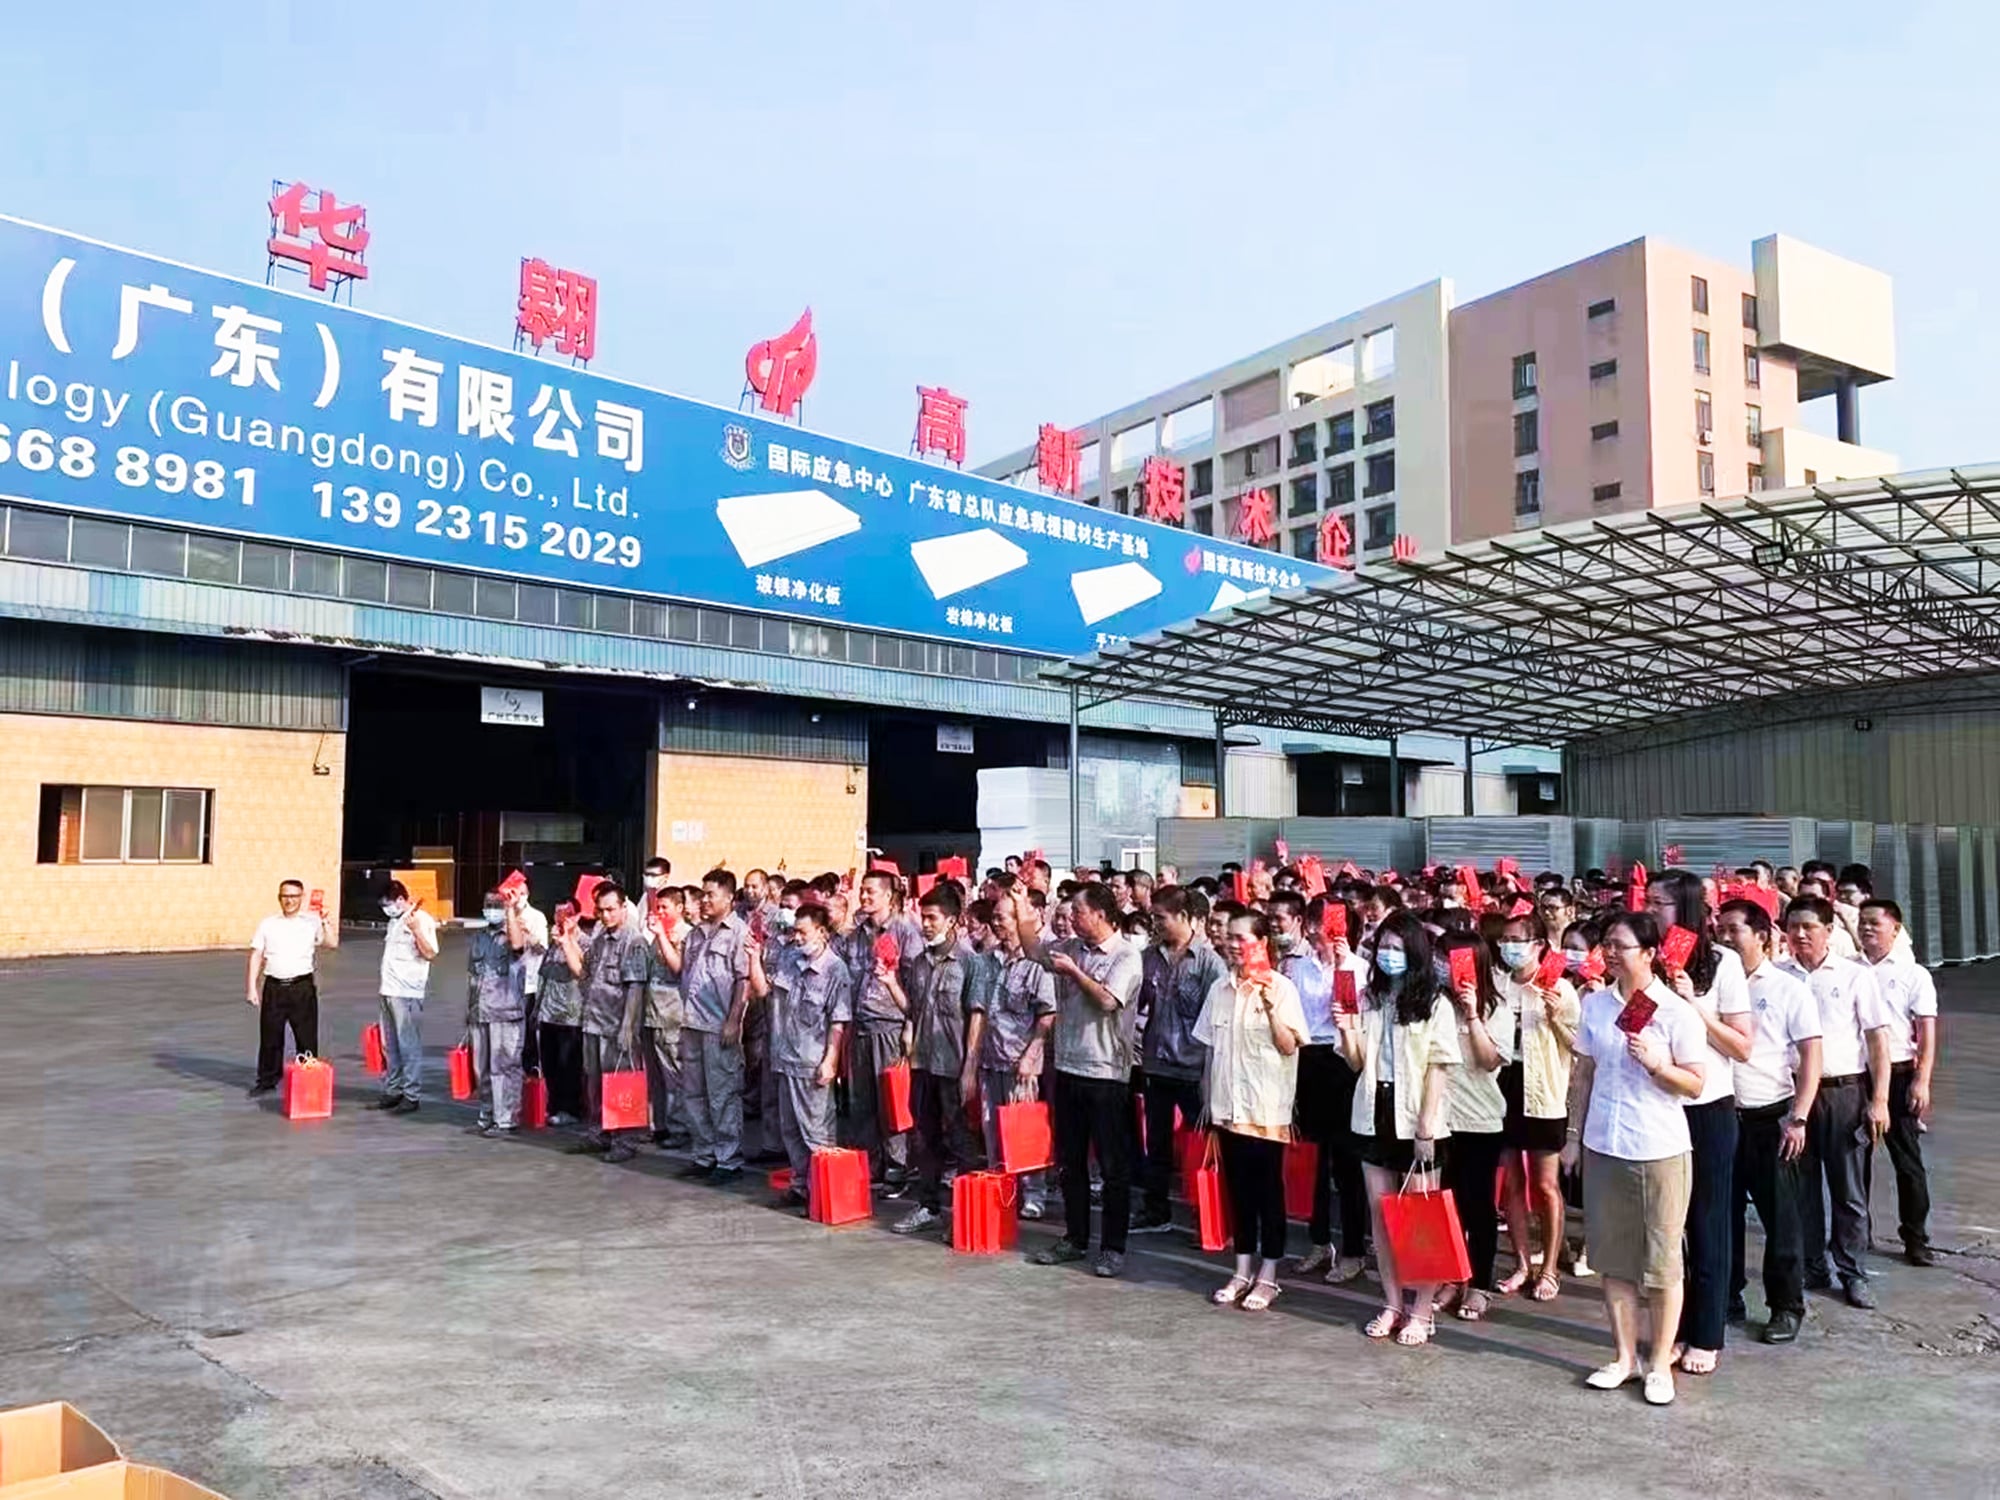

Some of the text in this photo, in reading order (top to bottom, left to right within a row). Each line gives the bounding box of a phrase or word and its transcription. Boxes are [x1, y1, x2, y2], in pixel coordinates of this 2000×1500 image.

[0, 422, 641, 568] 68 8981 139 2315 2029
[8, 360, 640, 518] logy (Guangdong) Co., Ltd.
[767, 443, 1149, 559] 国际应急中心 广东省总队应急救援建材生产基地
[755, 574, 841, 606] 玻镁净化板
